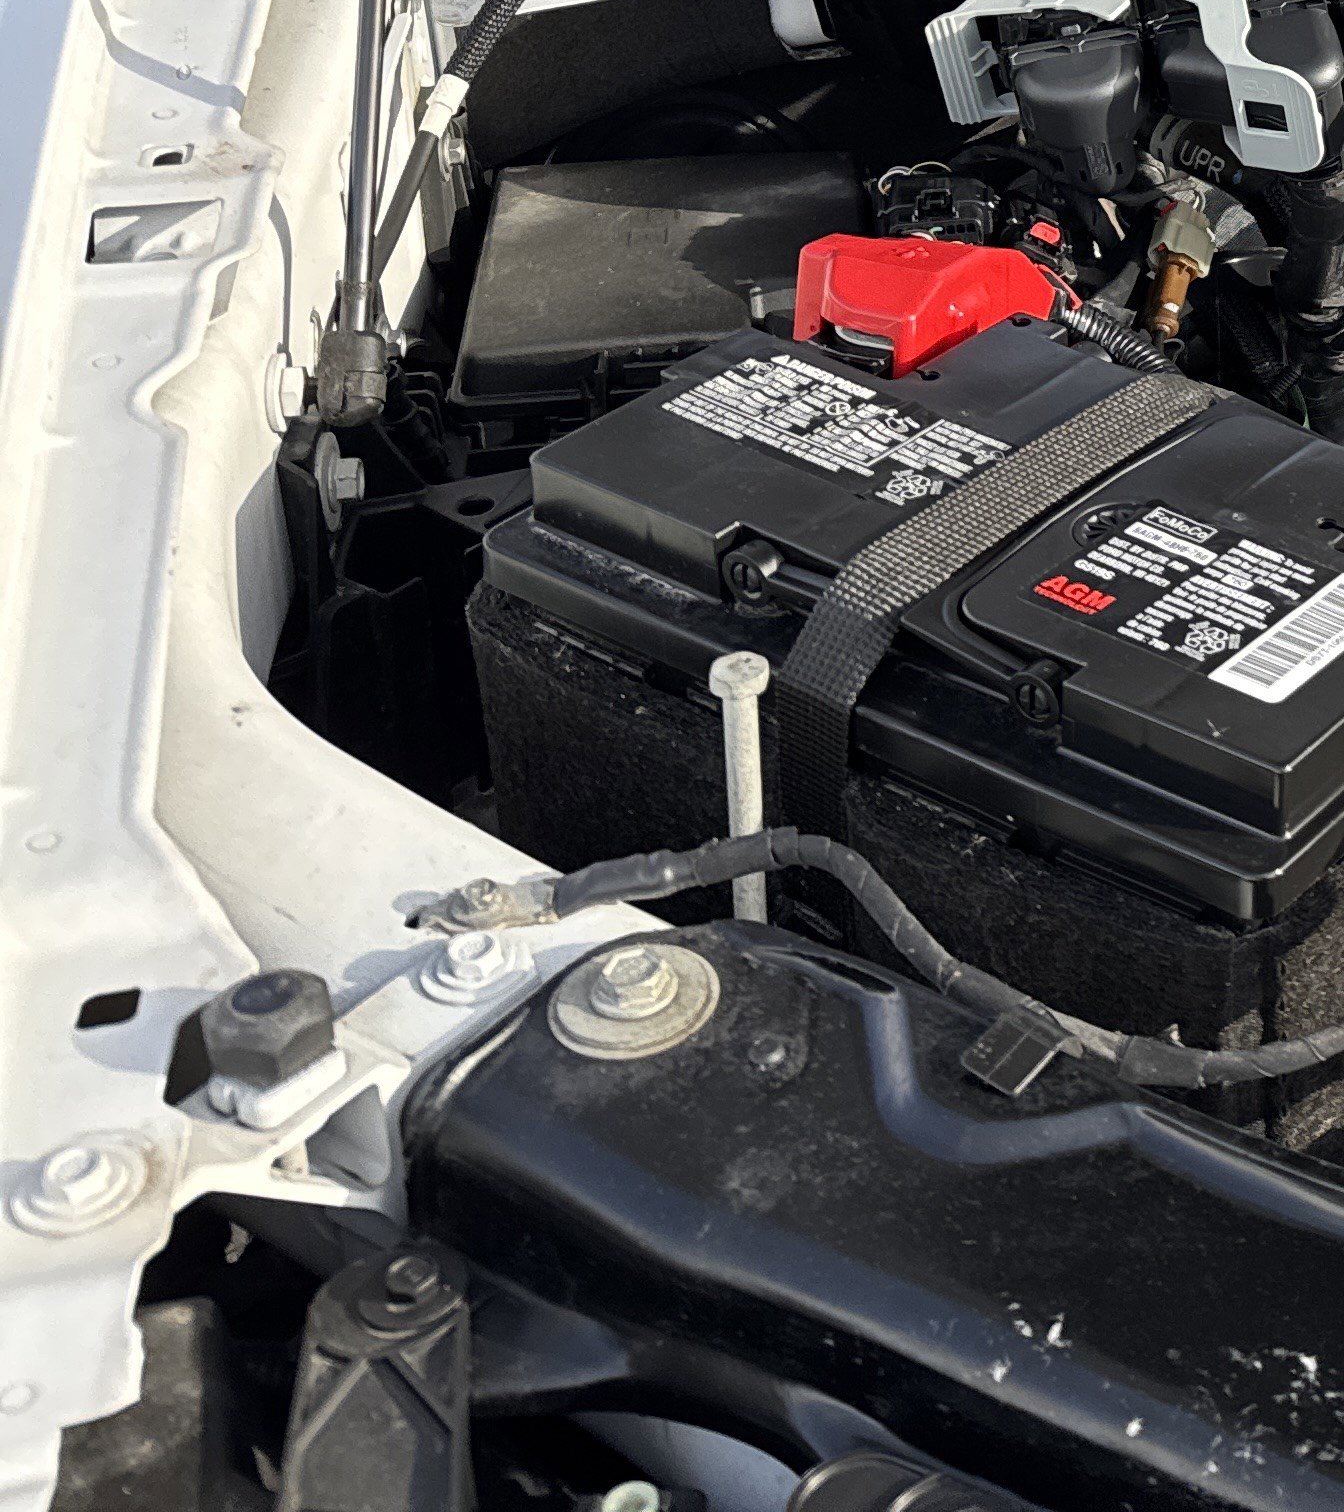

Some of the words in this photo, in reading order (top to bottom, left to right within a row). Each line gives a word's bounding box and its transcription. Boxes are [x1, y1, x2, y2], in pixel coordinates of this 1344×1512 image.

[1179, 139, 1226, 184] UPR
[1149, 509, 1209, 539] FoMoCo
[1039, 575, 1118, 611] AGM
